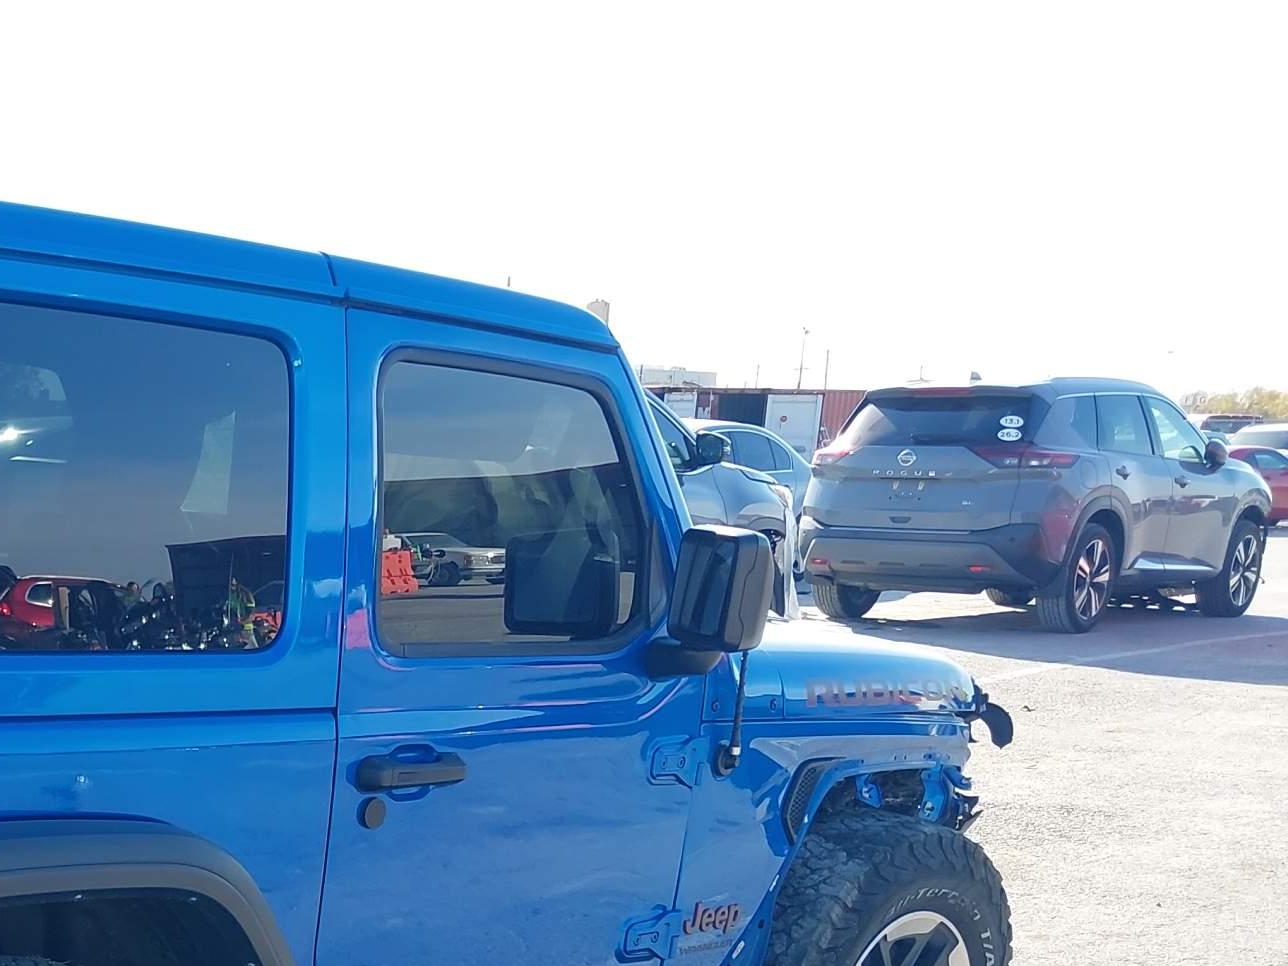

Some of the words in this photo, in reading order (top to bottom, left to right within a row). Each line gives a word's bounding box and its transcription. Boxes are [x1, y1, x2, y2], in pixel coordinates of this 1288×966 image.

[872, 469, 936, 477] ROGUE
[807, 679, 968, 708] RUBICON
[682, 900, 741, 936] Jeep
[886, 887, 982, 921] ll-Terrn
